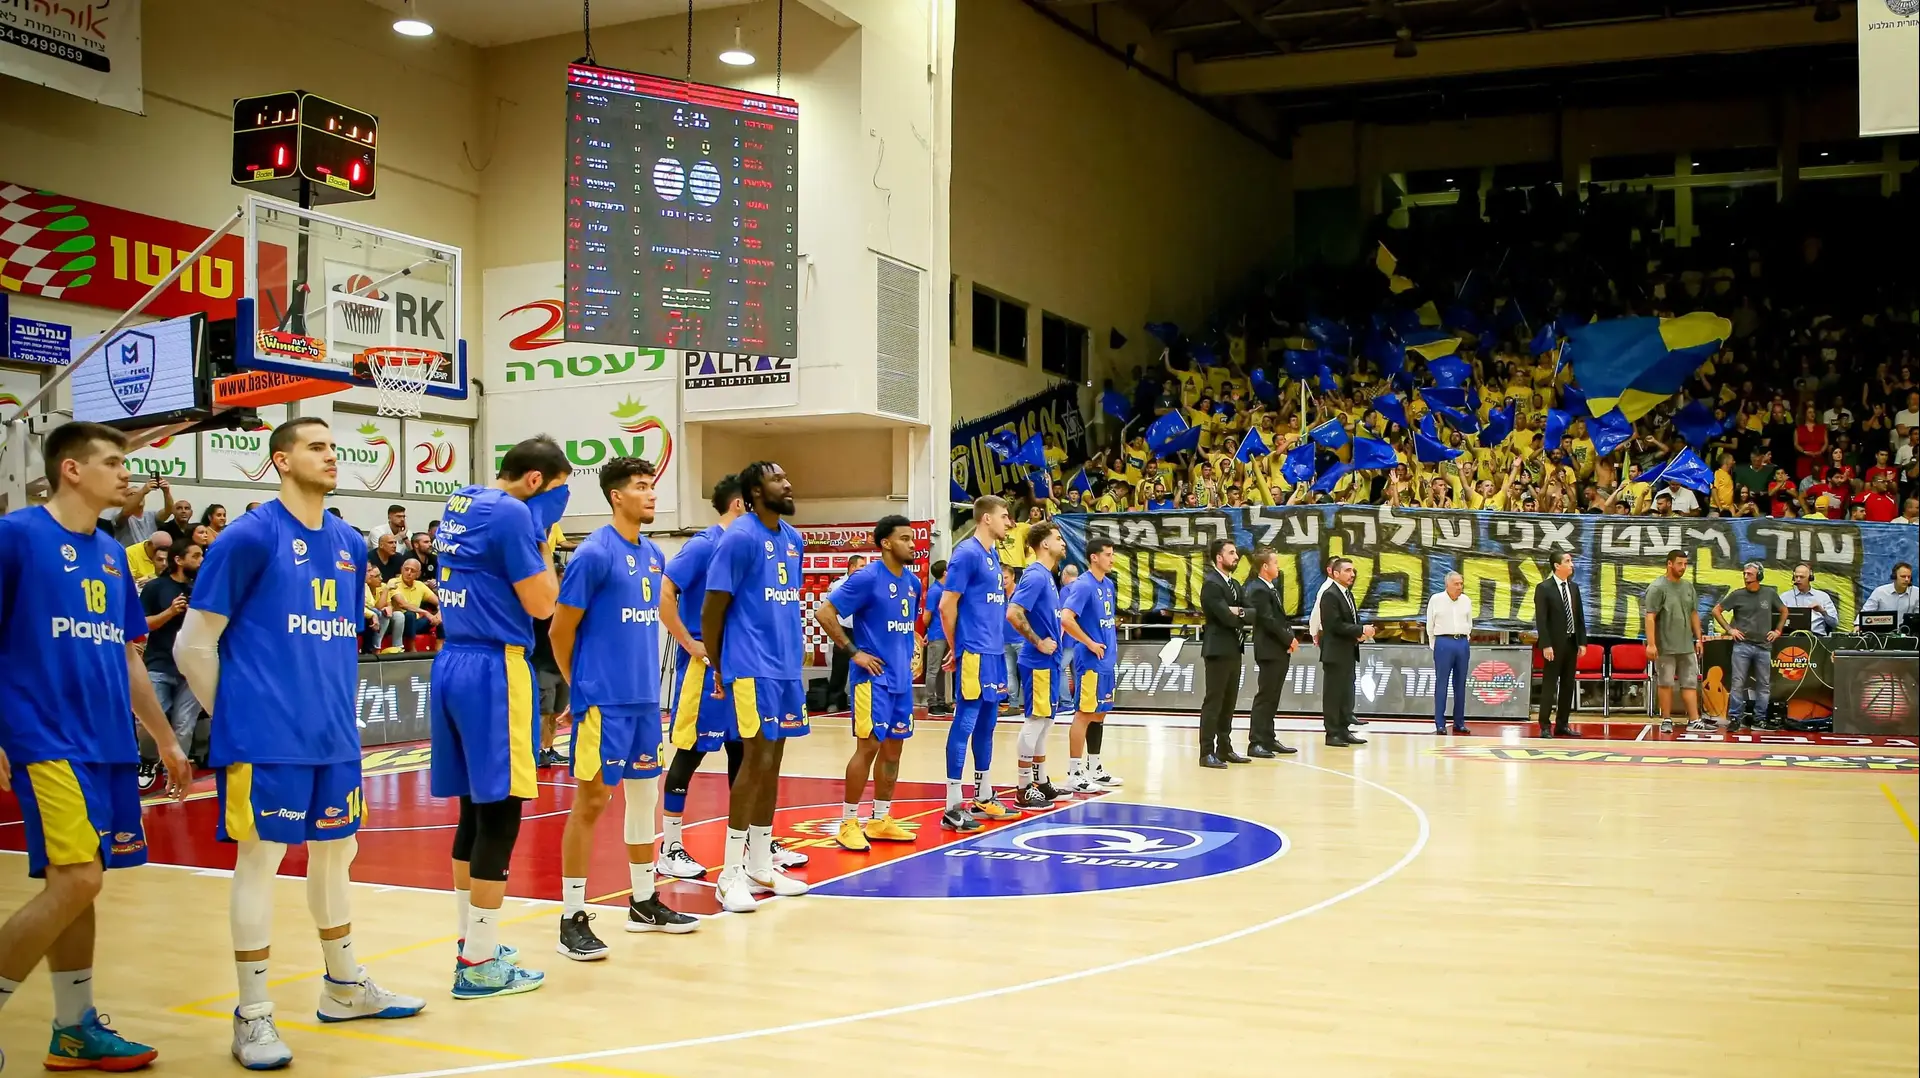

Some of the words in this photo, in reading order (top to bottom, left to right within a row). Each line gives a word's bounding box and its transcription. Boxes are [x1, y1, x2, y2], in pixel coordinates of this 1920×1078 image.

[24, 18, 76, 42] והקמות
[1868, 21, 1895, 31] הגלבוע
[81, 36, 106, 52] ציוד
[110, 235, 233, 299] טוטו
[15, 324, 67, 340] עמישב
[264, 334, 307, 354] Winner
[13, 352, 69, 365] 1-700-70-30-50
[505, 347, 666, 383] לעטרה
[721, 377, 755, 386] הנדסה
[210, 433, 261, 451] עטרה
[336, 446, 378, 464] עטרה
[1089, 517, 1228, 546] הבמה
[1249, 505, 1319, 546] על
[1341, 505, 1473, 549] עולה
[1496, 520, 1575, 551] אני
[1756, 528, 1854, 564] עוד
[777, 562, 788, 585] 5
[81, 578, 107, 614] 18
[311, 578, 338, 612] 14
[641, 577, 652, 602] 6
[901, 599, 909, 617] 3
[1770, 659, 1809, 668] Winner
[278, 808, 306, 821] Rapyd
